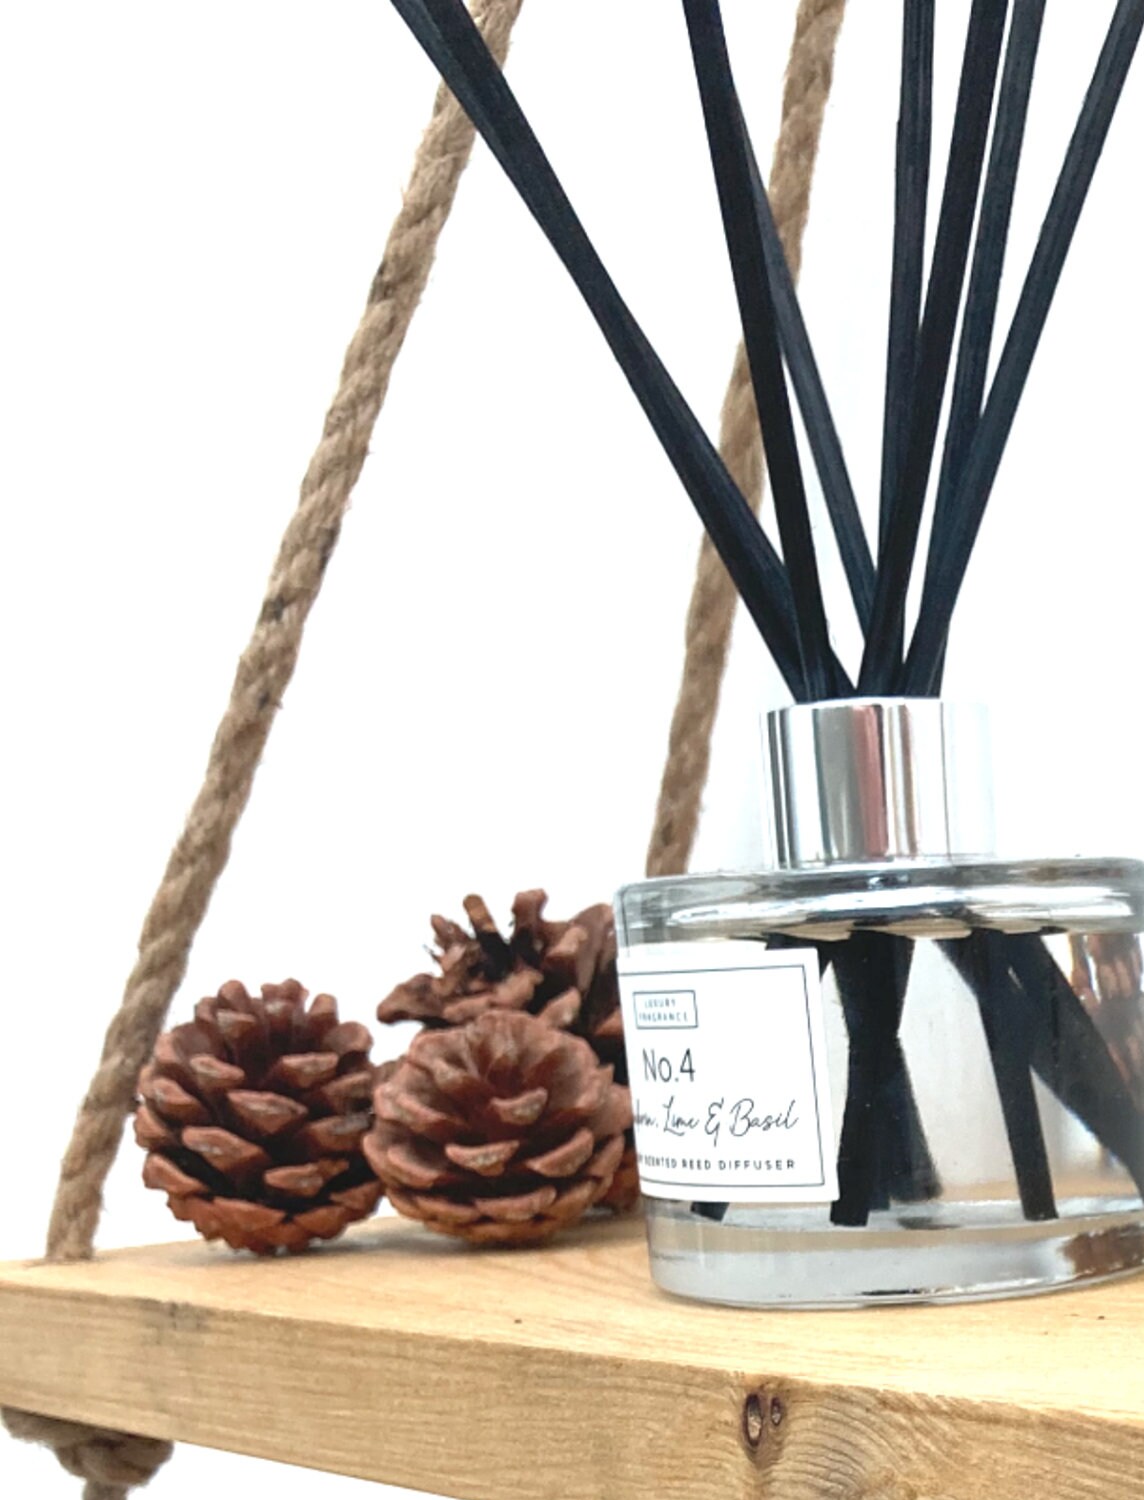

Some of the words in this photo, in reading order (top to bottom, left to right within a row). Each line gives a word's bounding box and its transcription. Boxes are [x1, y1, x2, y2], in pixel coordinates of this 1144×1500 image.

[642, 1047, 696, 1083] No.4
[662, 1095, 700, 1136] Lime
[704, 1097, 725, 1147] &
[729, 1098, 799, 1137] Basil
[682, 1158, 711, 1170] REED
[719, 1159, 796, 1171] DIFFUSER
